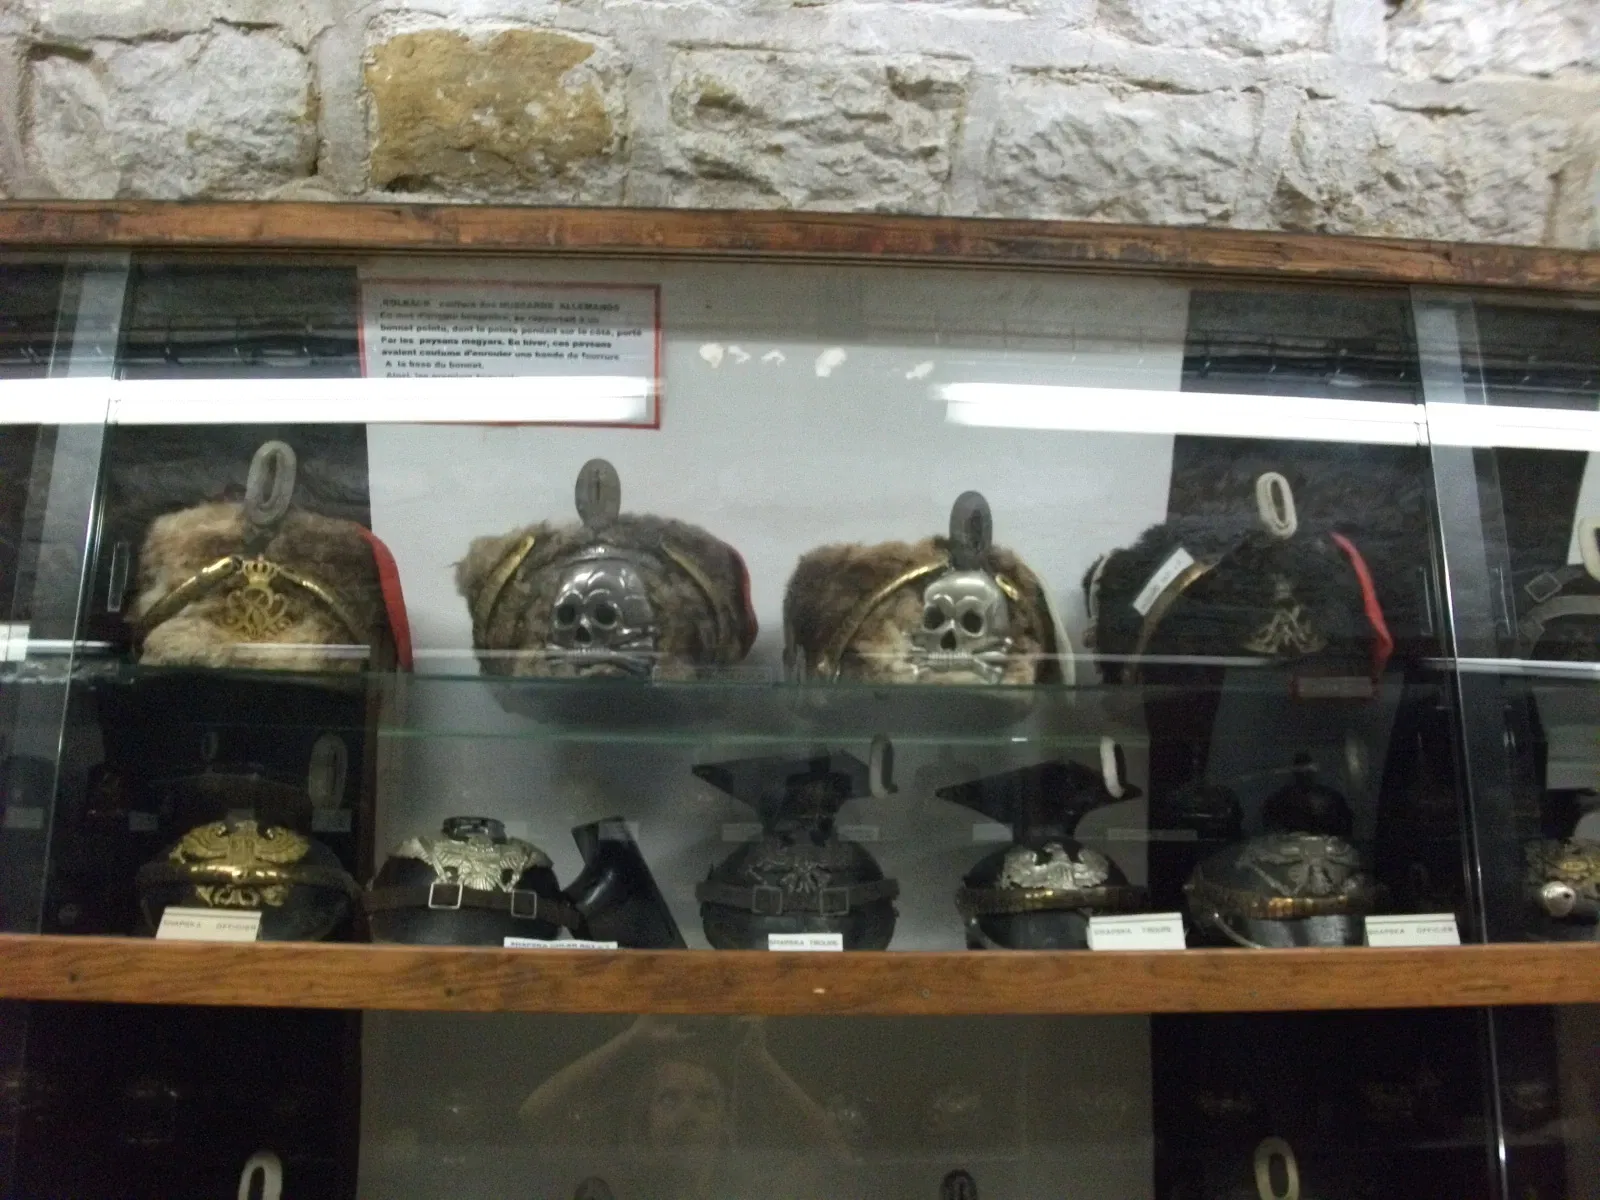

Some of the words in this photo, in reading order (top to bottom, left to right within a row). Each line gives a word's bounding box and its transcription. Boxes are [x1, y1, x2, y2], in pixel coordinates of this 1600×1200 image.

[380, 323, 414, 332] bonnet
[452, 324, 474, 333] dont
[418, 338, 459, 346] paysans
[572, 340, 612, 349] paysans
[381, 348, 417, 356] avaient
[419, 349, 461, 357] coutume
